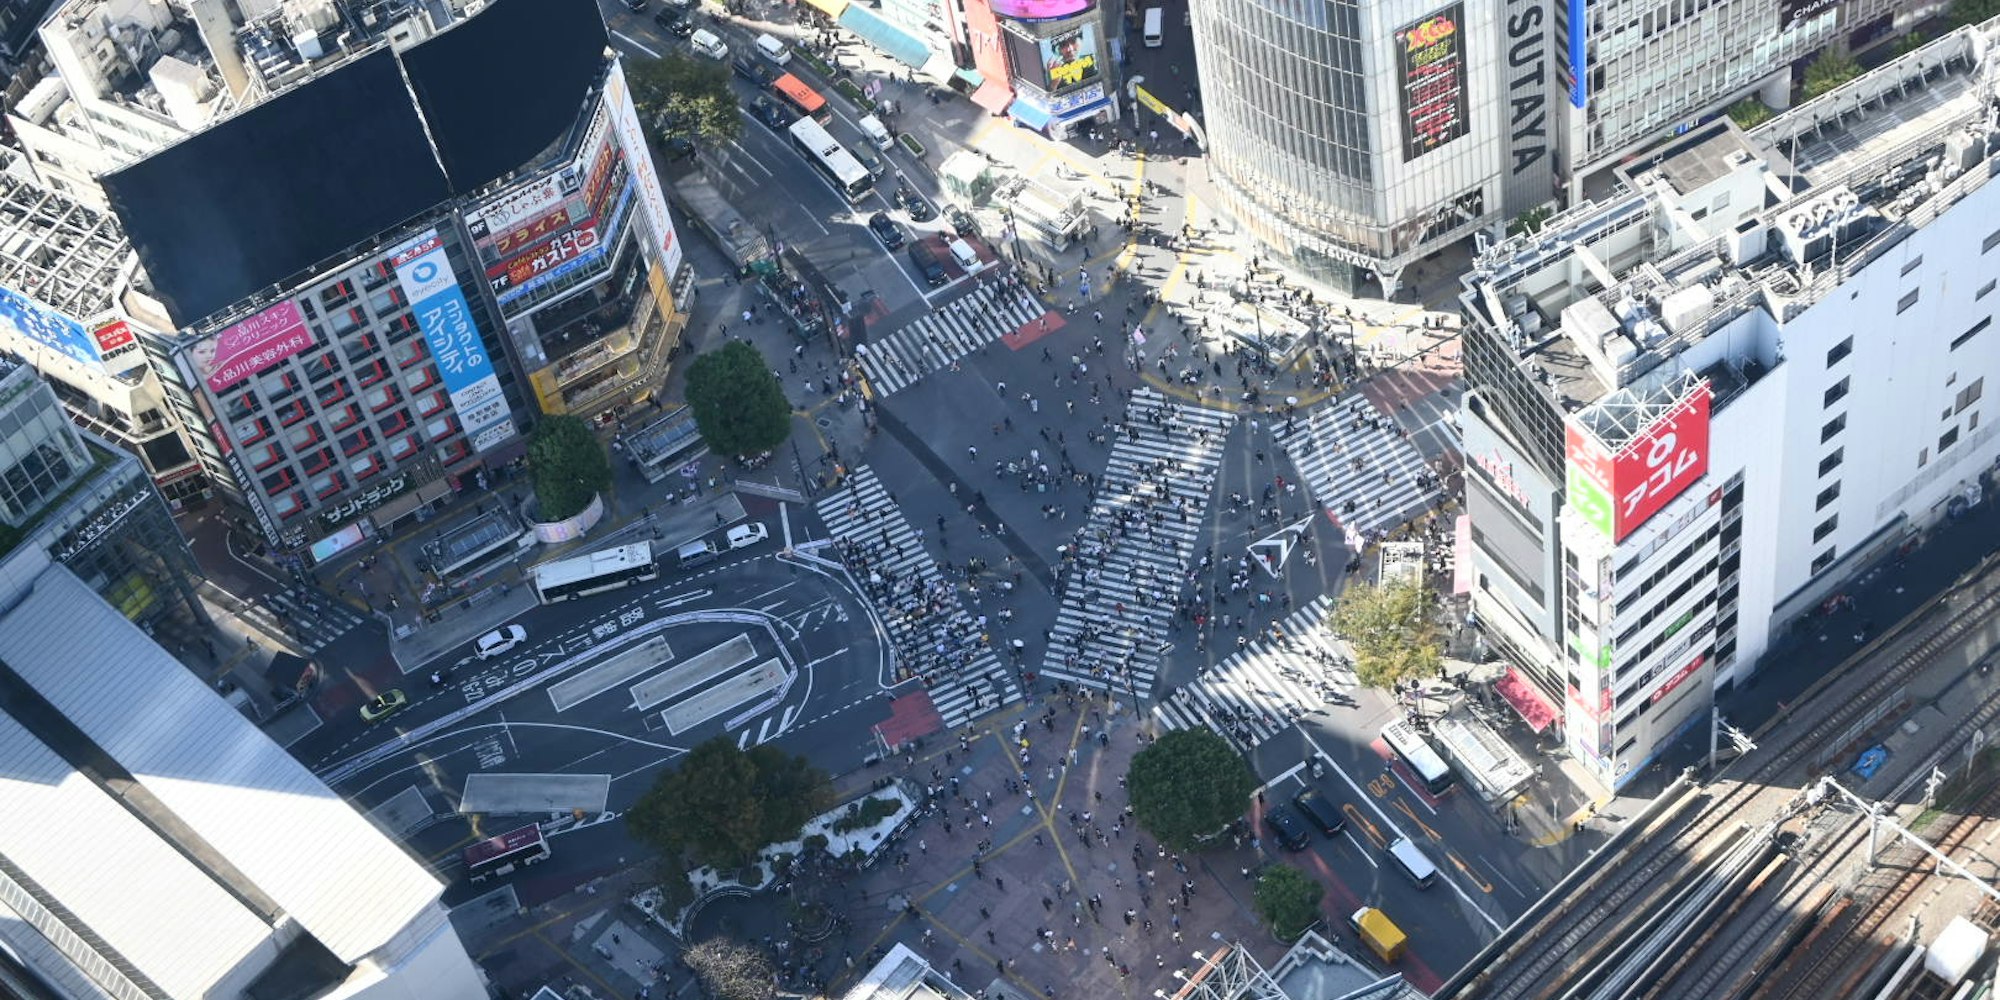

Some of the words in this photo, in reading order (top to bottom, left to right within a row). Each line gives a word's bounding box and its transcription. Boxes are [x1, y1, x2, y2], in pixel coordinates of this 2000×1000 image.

[1507, 0, 1546, 176] SUTAYA
[471, 222, 485, 235] 9F
[1418, 195, 1483, 231] TSUTAYA
[532, 245, 573, 273] ガスト
[1320, 248, 1378, 271] TSUTAYA
[492, 275, 509, 289] 7F
[237, 307, 289, 337] 品川スキン
[422, 306, 463, 374] アイシティ
[445, 298, 482, 367] コンタクトの
[223, 335, 304, 382] 品川美容外科
[326, 476, 405, 523] サンドラッグ
[1622, 448, 1699, 518] アコム
